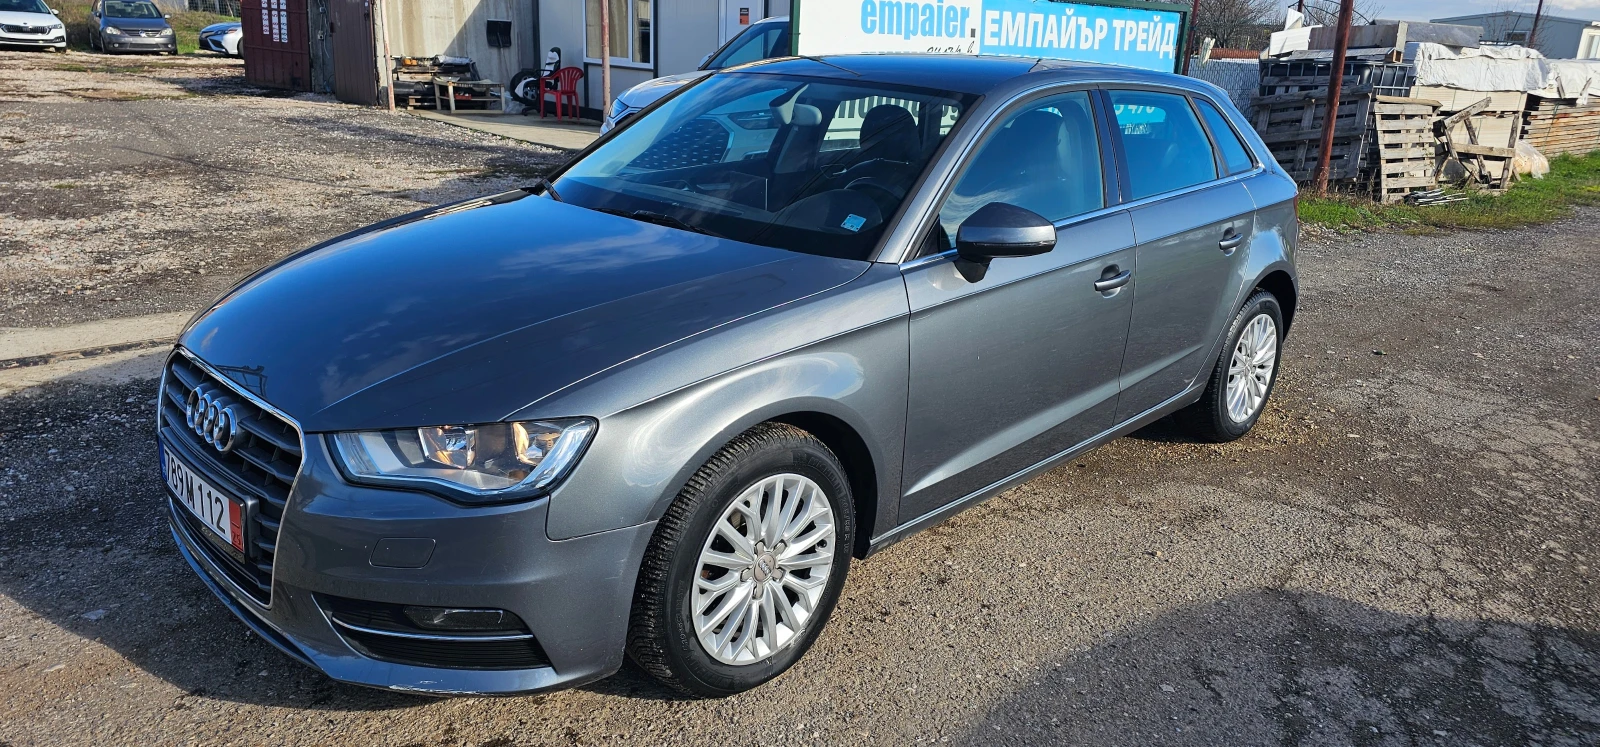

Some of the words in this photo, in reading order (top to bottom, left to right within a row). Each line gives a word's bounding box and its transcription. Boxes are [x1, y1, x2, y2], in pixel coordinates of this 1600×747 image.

[983, 8, 1108, 50] ЕМПАЙЪР
[1113, 15, 1177, 59] ТРЕЙД
[232, 533, 241, 544] 25
